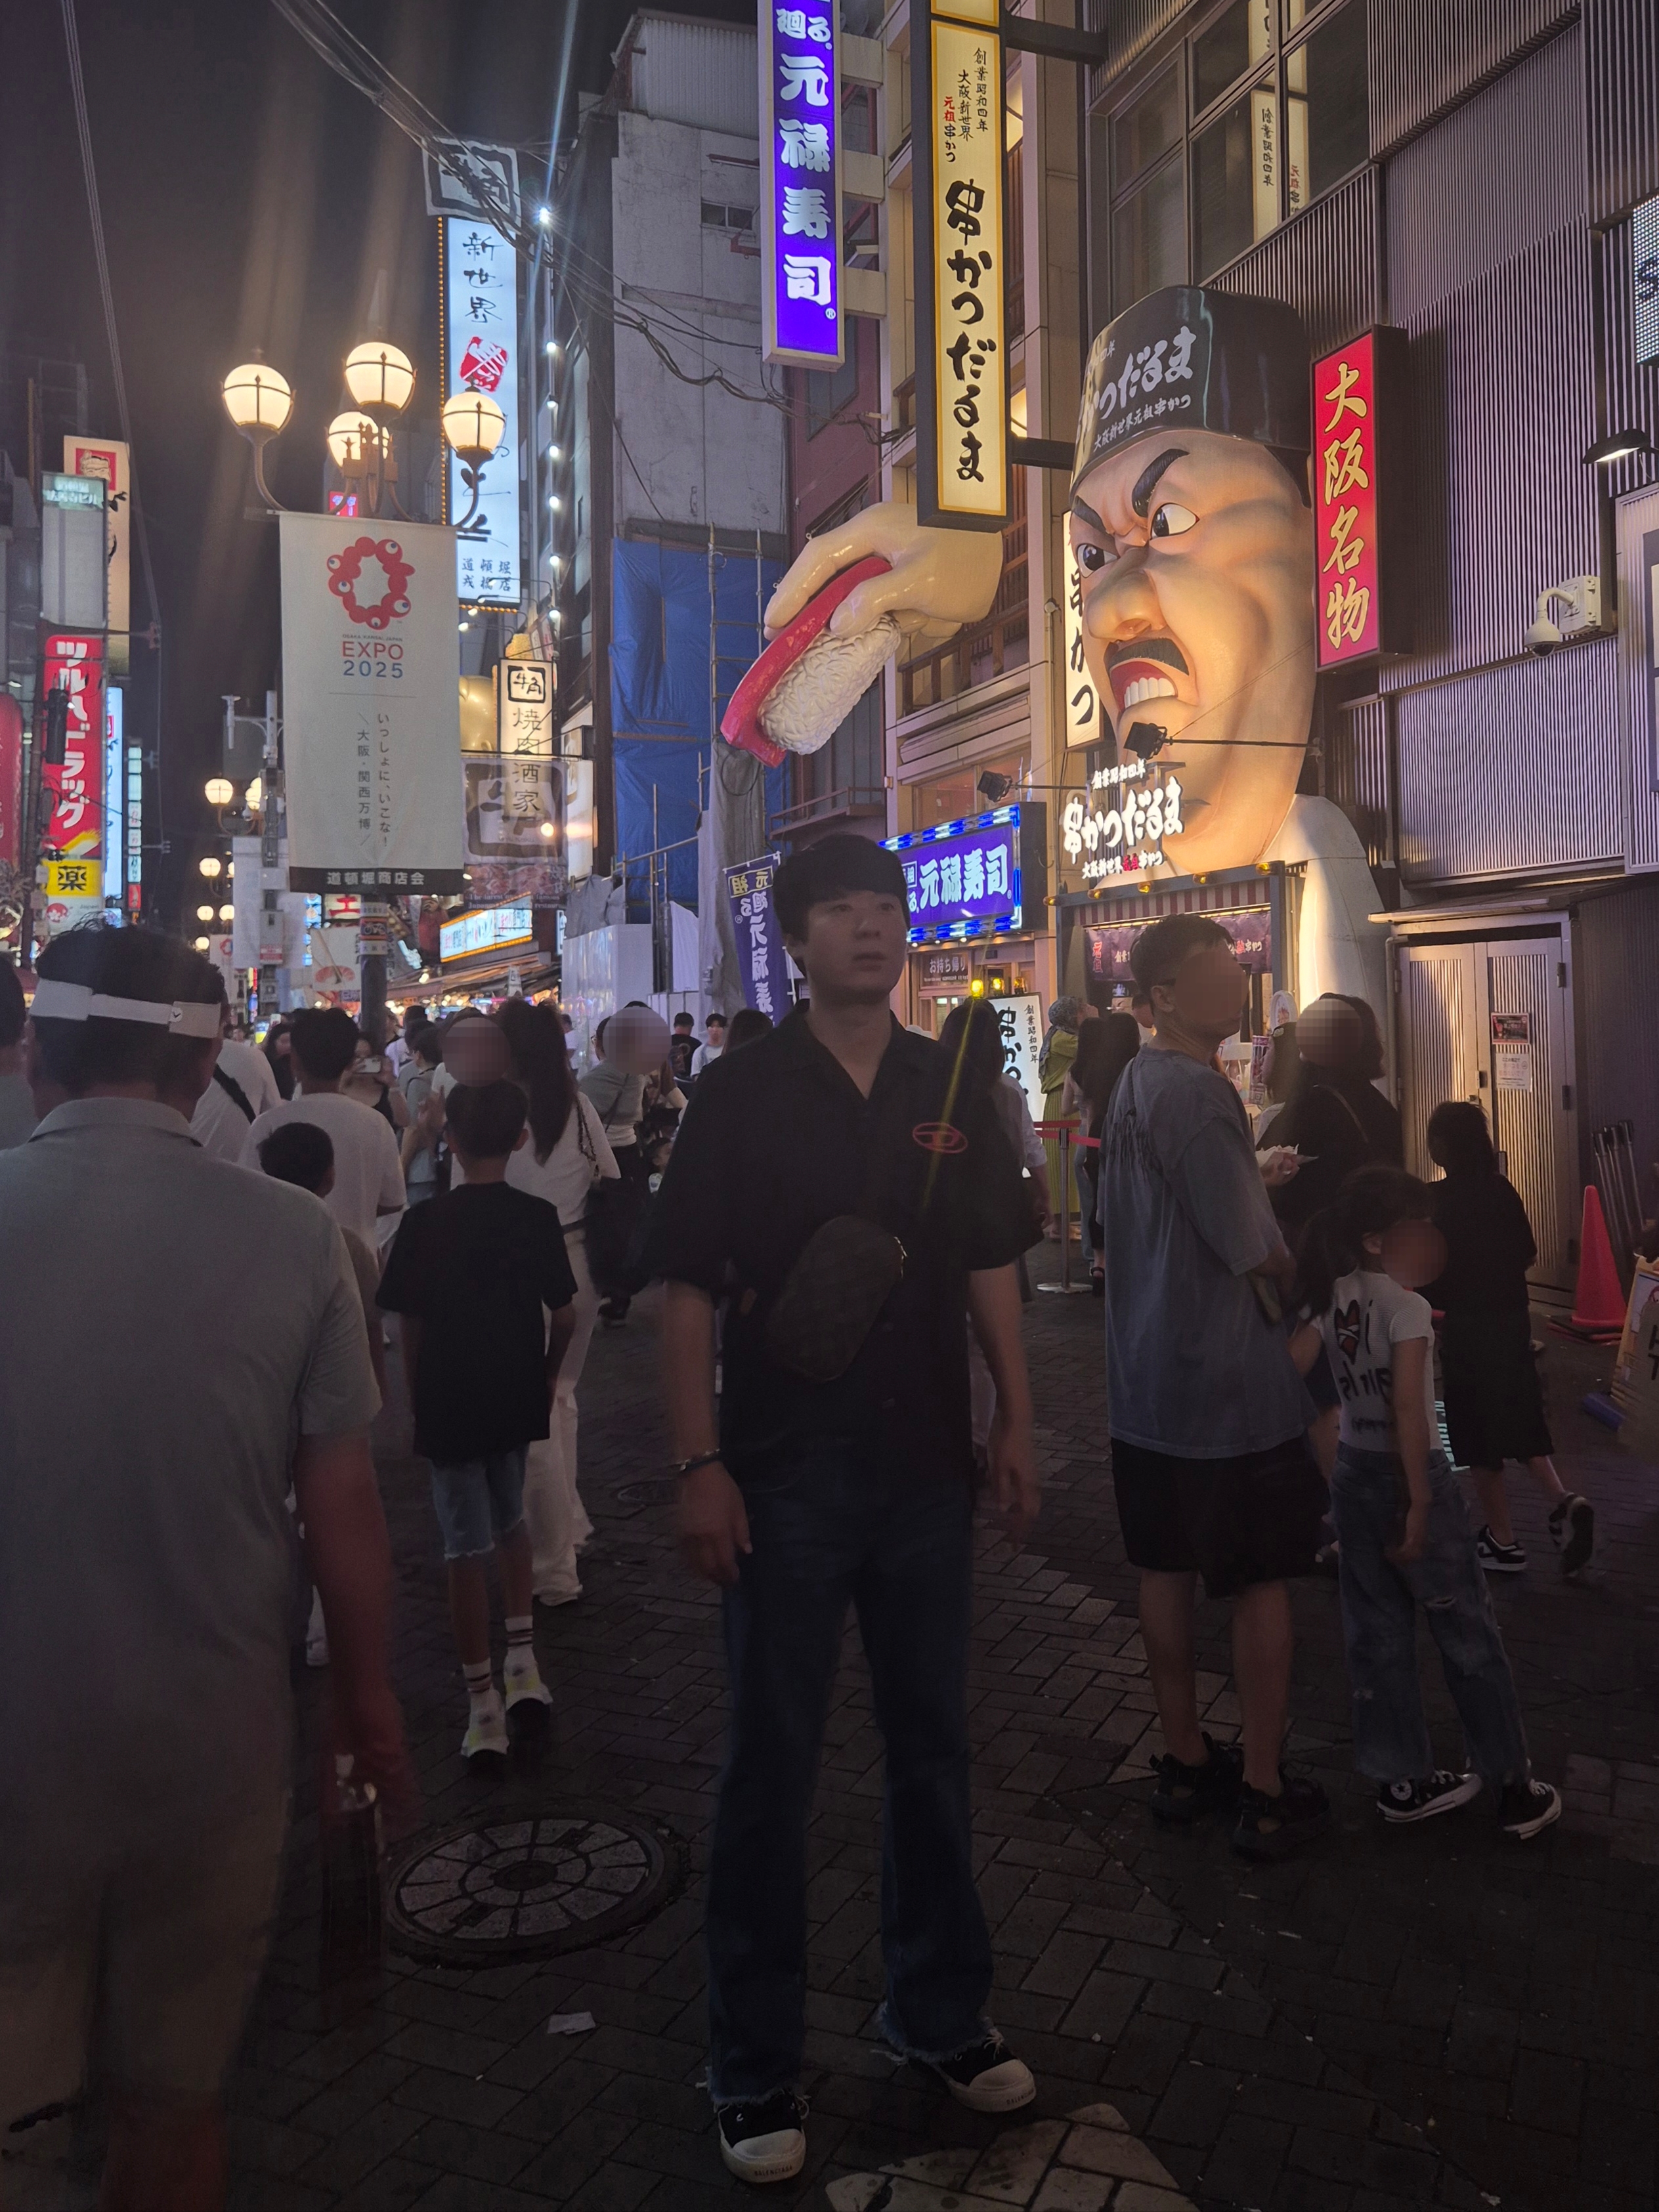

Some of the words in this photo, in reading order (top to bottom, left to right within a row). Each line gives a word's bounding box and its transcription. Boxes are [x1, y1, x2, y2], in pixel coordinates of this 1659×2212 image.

[957, 69, 974, 142] 大阪新世界
[974, 47, 989, 132] 創業昭和四年
[943, 96, 957, 163] 元祖串かつ
[463, 232, 504, 323] 新世界
[945, 179, 997, 482] 串かつだるま
[1093, 394, 1191, 453] 大阪新世界元祖串かつ
[1323, 362, 1369, 650] 大阪名物
[462, 558, 511, 576] 道頓堀
[343, 641, 404, 660] EXPO
[343, 660, 403, 679] 2025
[513, 672, 542, 695] 牛角
[1091, 758, 1147, 790] 創業昭和四年
[1064, 776, 1184, 864] 串かつだるま
[58, 865, 87, 891] 薬
[326, 872, 425, 885] 道頓堀商店会
[930, 956, 966, 974] お持ち帰り
[1024, 1004, 1039, 1063] 創業昭和四年
